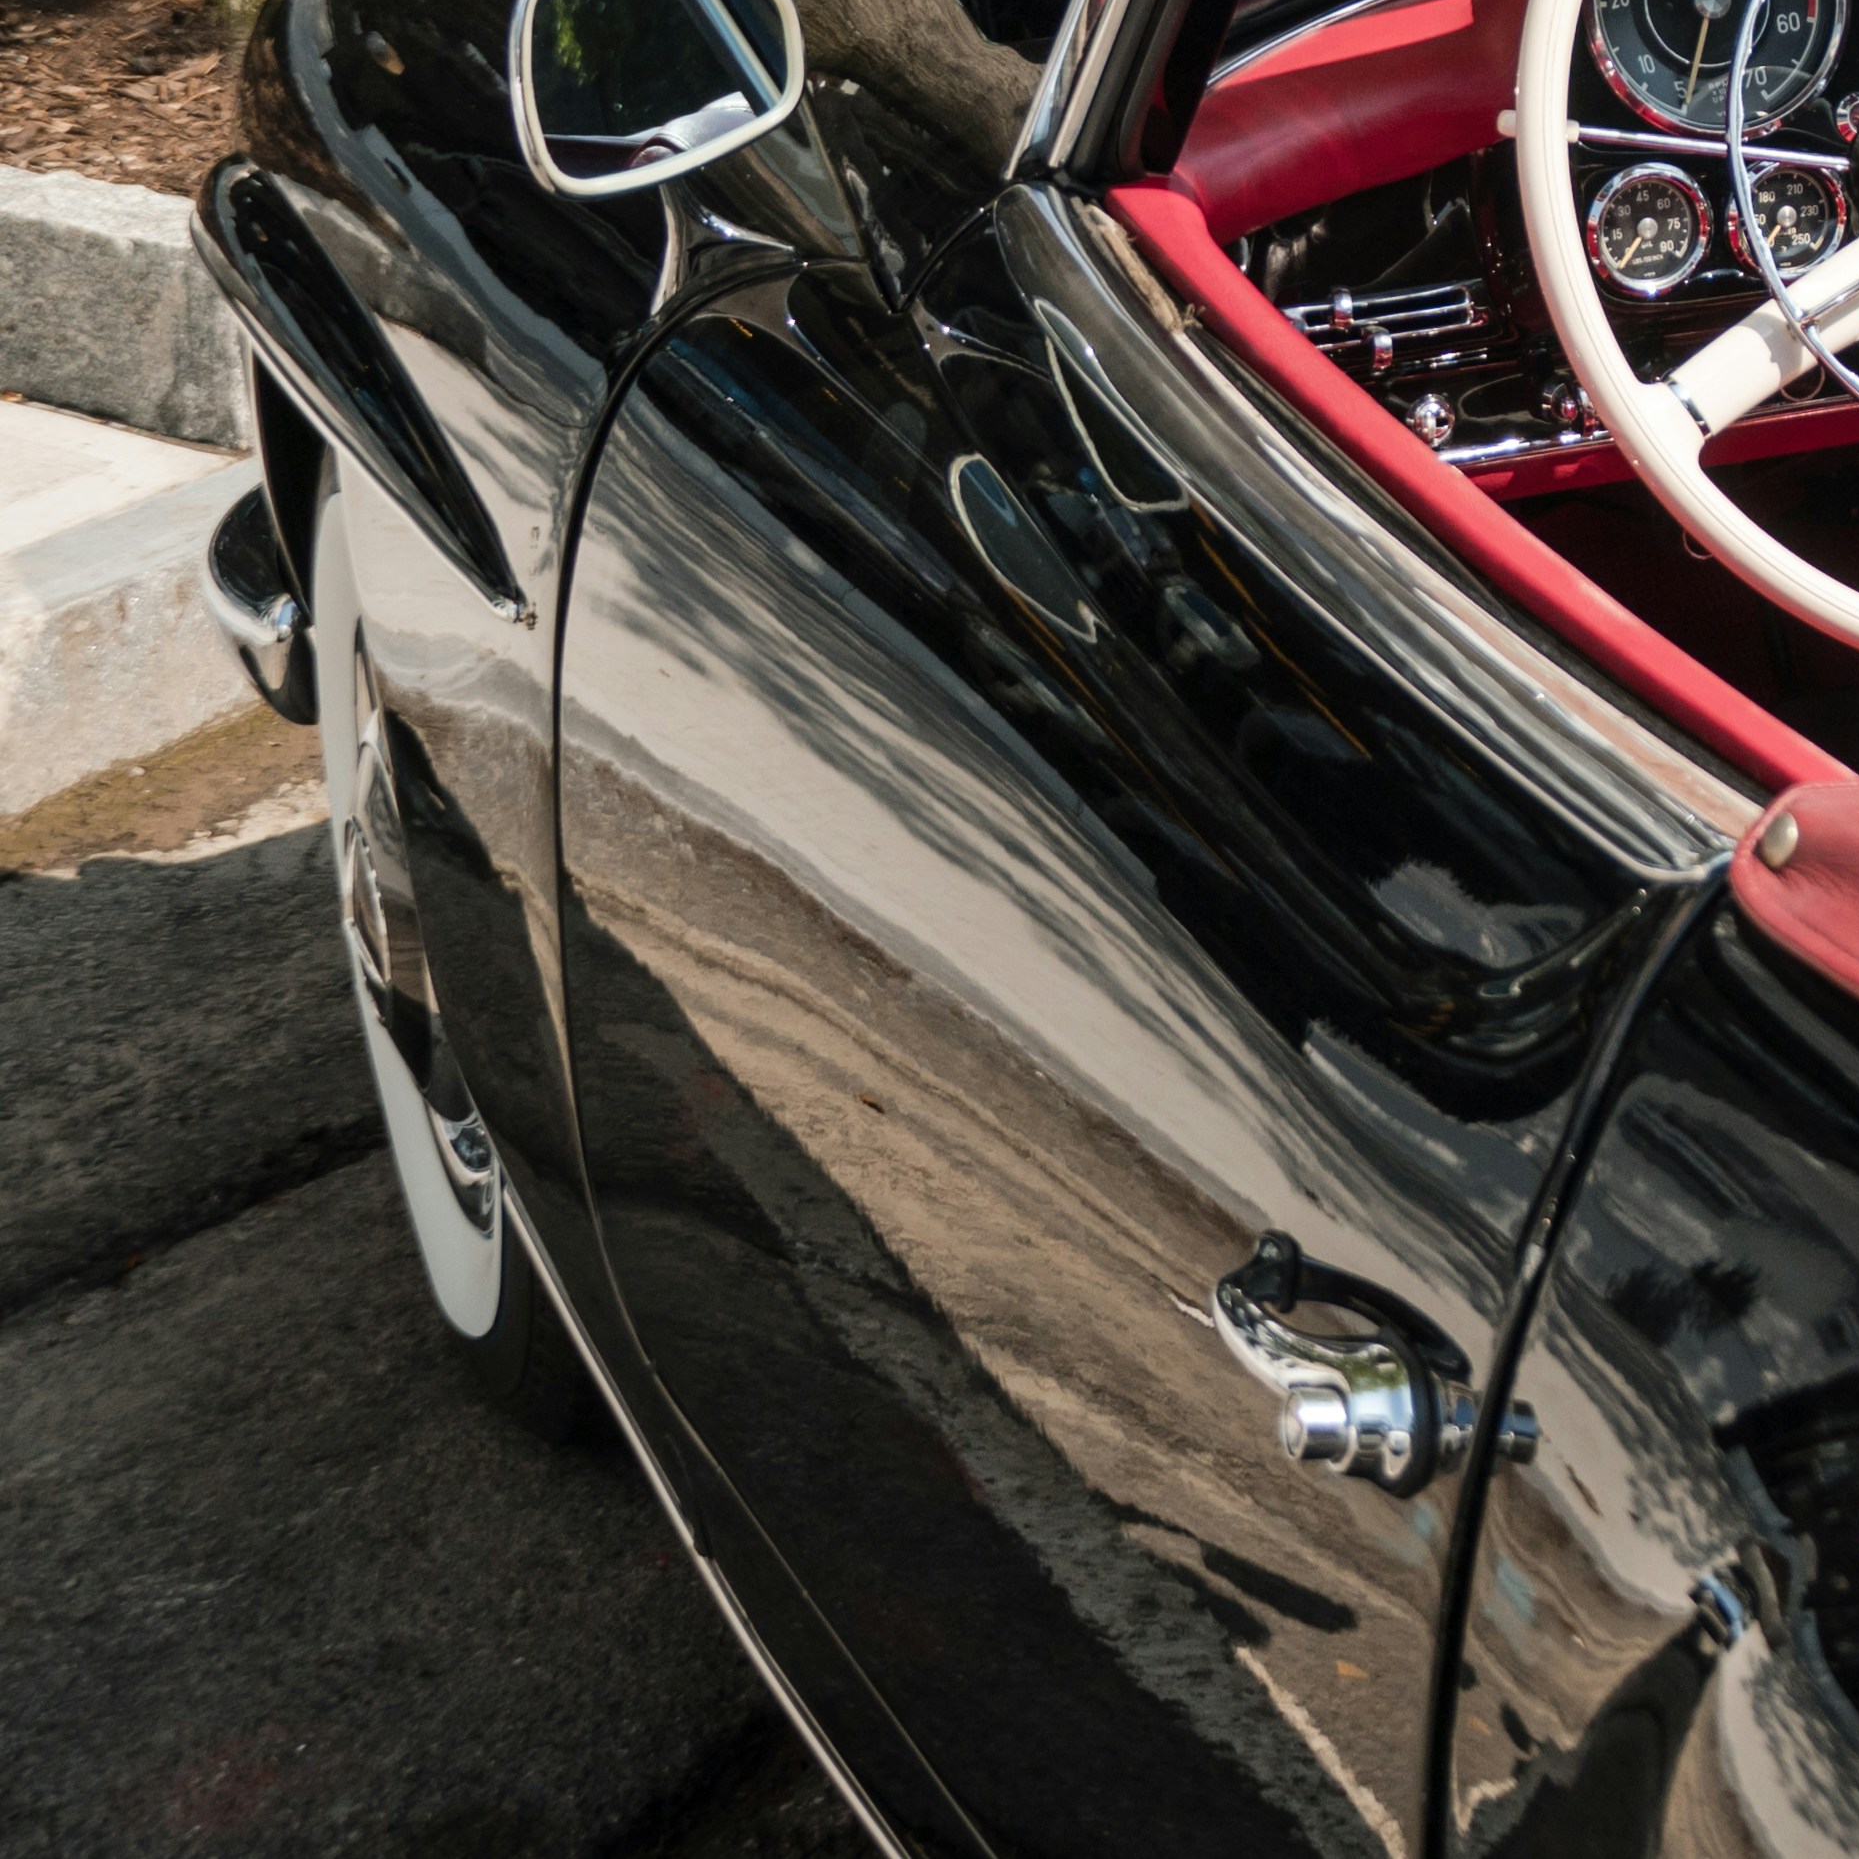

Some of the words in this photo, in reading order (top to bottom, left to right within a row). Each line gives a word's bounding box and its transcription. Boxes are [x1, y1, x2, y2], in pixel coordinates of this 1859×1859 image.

[1777, 12, 1800, 34] 60
[1638, 54, 1655, 74] 10
[1745, 67, 1767, 89] 70
[1787, 183, 1804, 195] 210
[1636, 190, 1649, 201] 45
[1759, 191, 1775, 202] 180
[1657, 198, 1671, 209] 60
[1618, 205, 1631, 217] 30
[1800, 205, 1819, 217] 230
[1667, 217, 1681, 230] 75
[1612, 228, 1623, 240] 15
[1792, 233, 1811, 246] 250
[1660, 240, 1674, 253] 90
